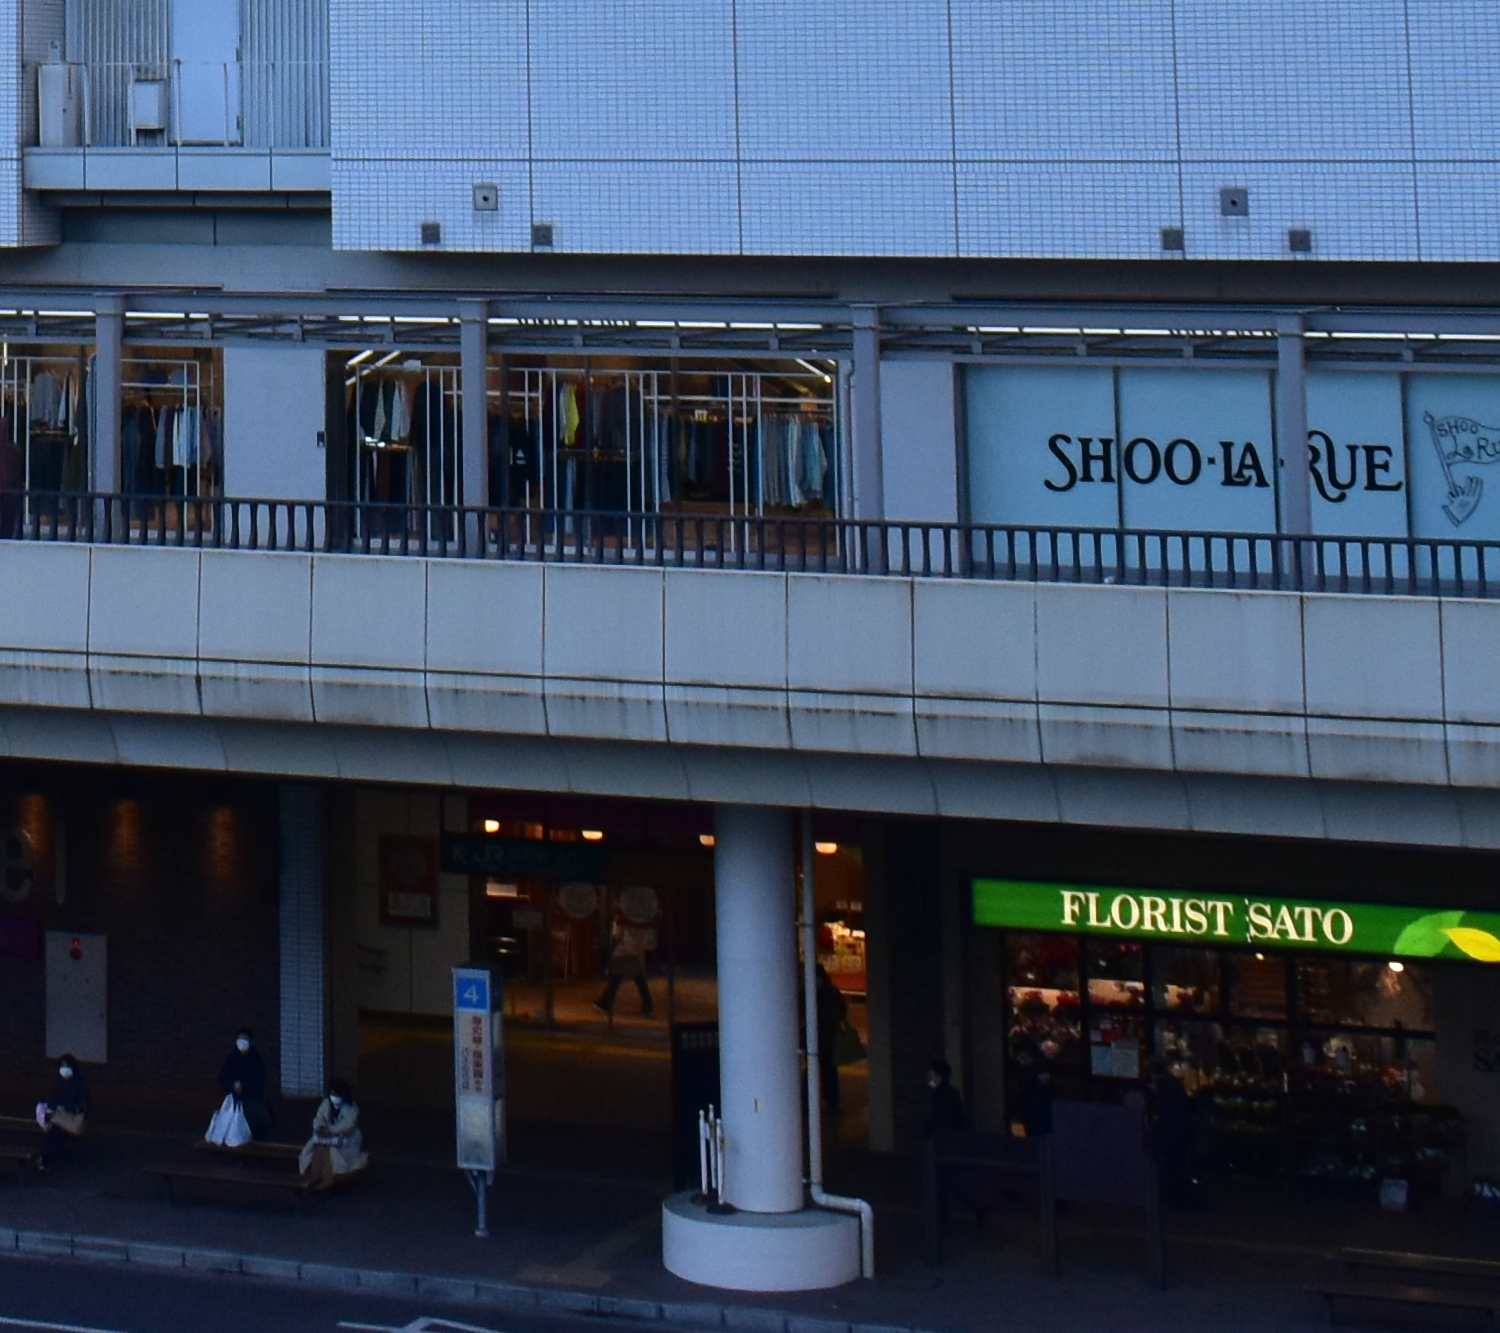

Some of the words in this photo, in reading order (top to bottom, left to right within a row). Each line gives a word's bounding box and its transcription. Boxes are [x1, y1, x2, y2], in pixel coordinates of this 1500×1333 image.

[1061, 890, 1233, 936] FLORIST
[1249, 902, 1353, 944] SATO
[463, 985, 480, 1004] 4
